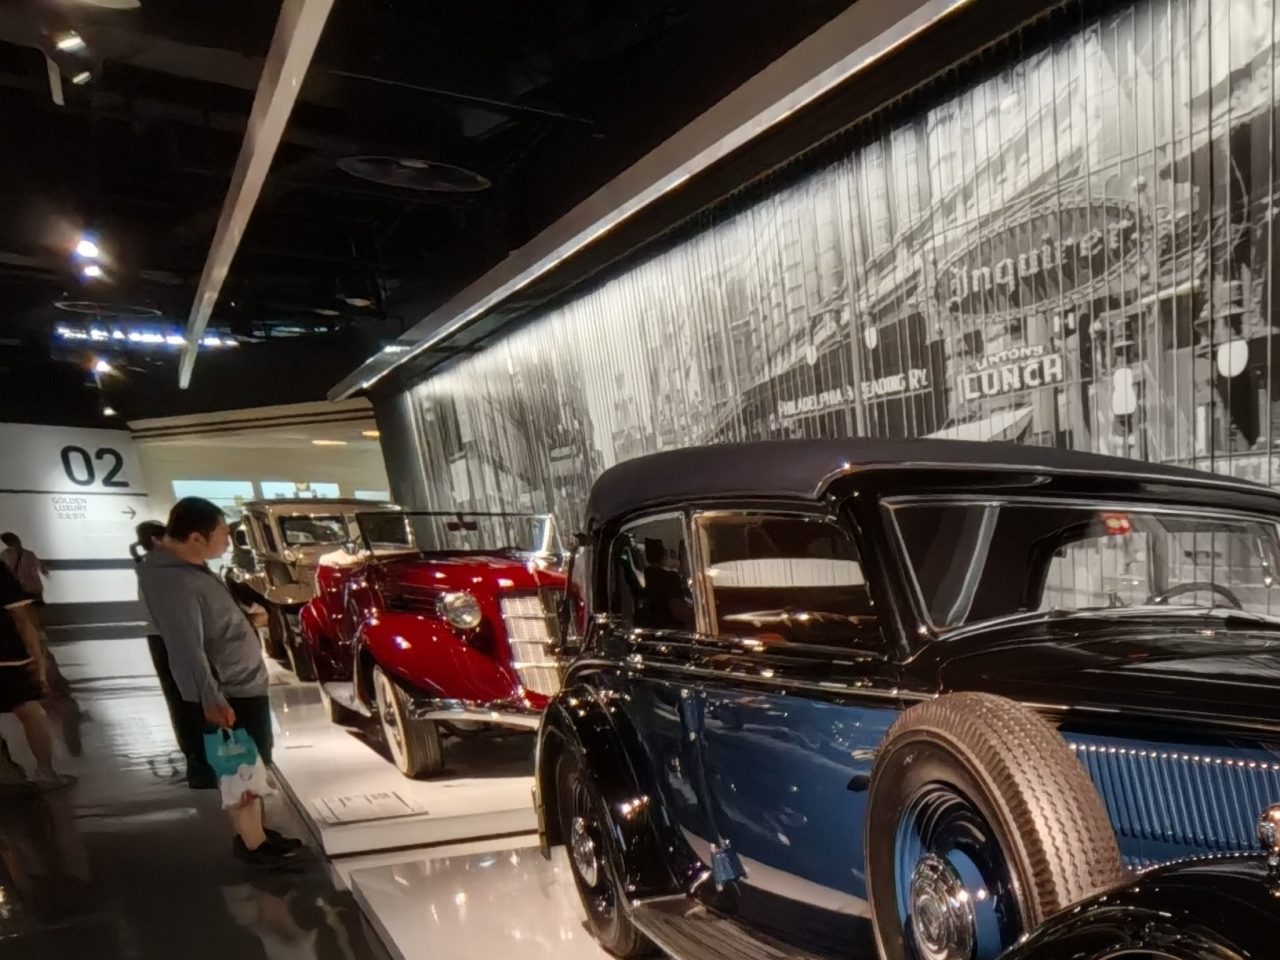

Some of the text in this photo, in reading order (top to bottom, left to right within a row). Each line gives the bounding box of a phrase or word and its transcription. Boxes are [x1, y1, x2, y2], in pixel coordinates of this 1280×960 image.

[947, 218, 1135, 303] Inquirer
[859, 373, 907, 400] EADING
[962, 353, 1063, 401] LUNCH
[60, 445, 130, 488] 02
